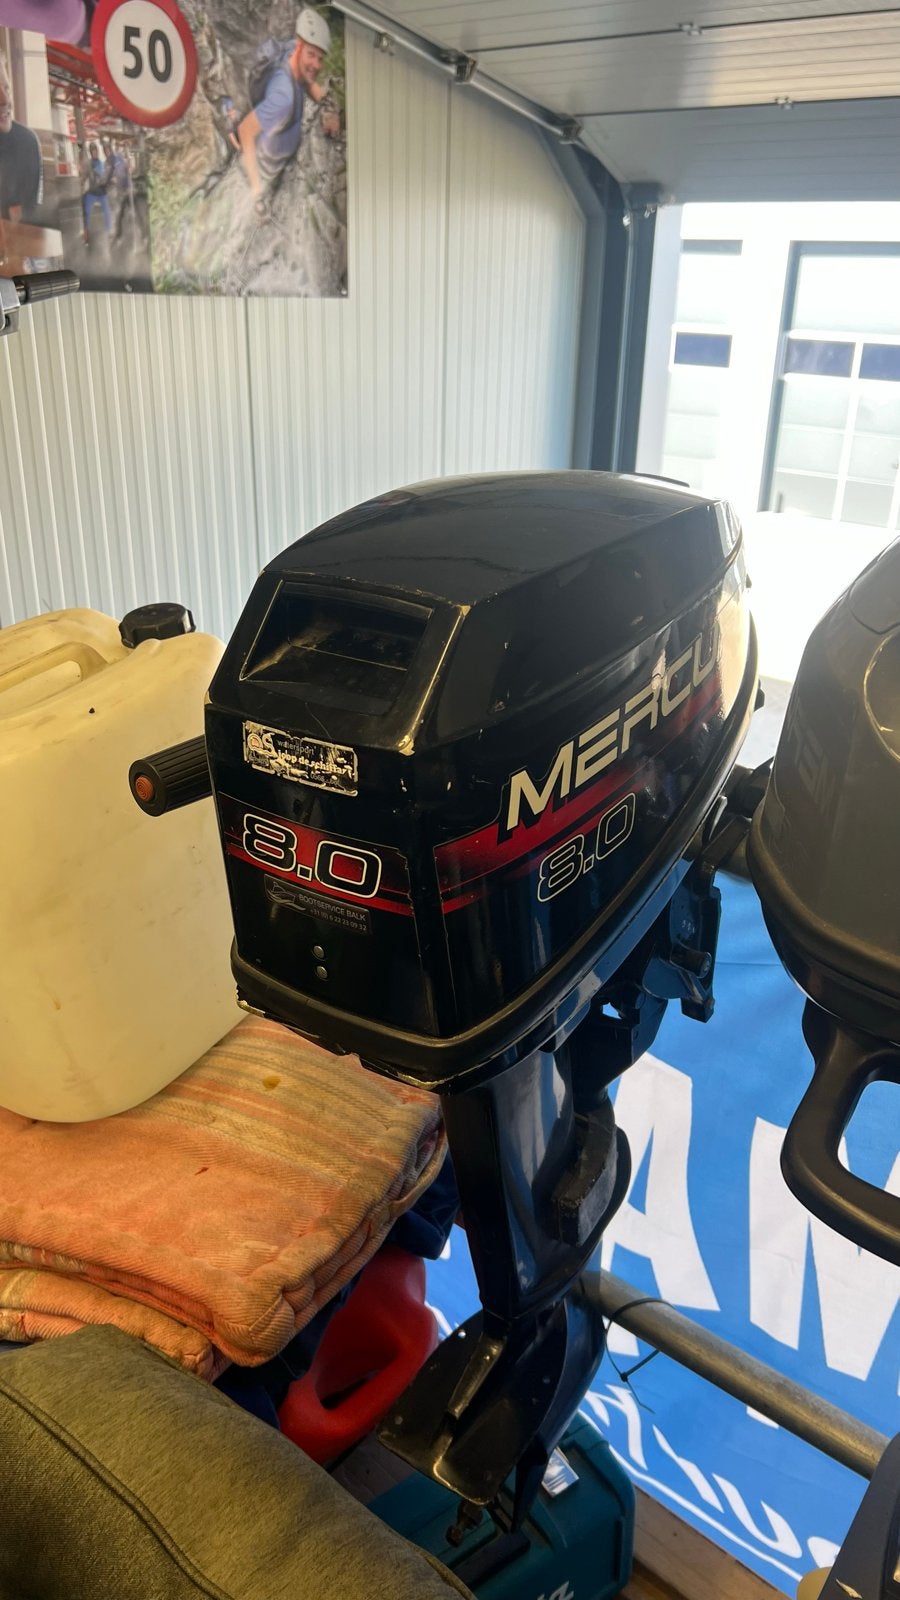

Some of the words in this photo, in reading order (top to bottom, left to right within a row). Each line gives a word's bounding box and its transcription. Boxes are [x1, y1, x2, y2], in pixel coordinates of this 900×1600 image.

[123, 25, 173, 84] 50
[243, 813, 382, 899] 8.0
[537, 793, 636, 902] 8.0
[298, 893, 345, 915] BOOTSERVICE
[346, 909, 367, 922] BALK
